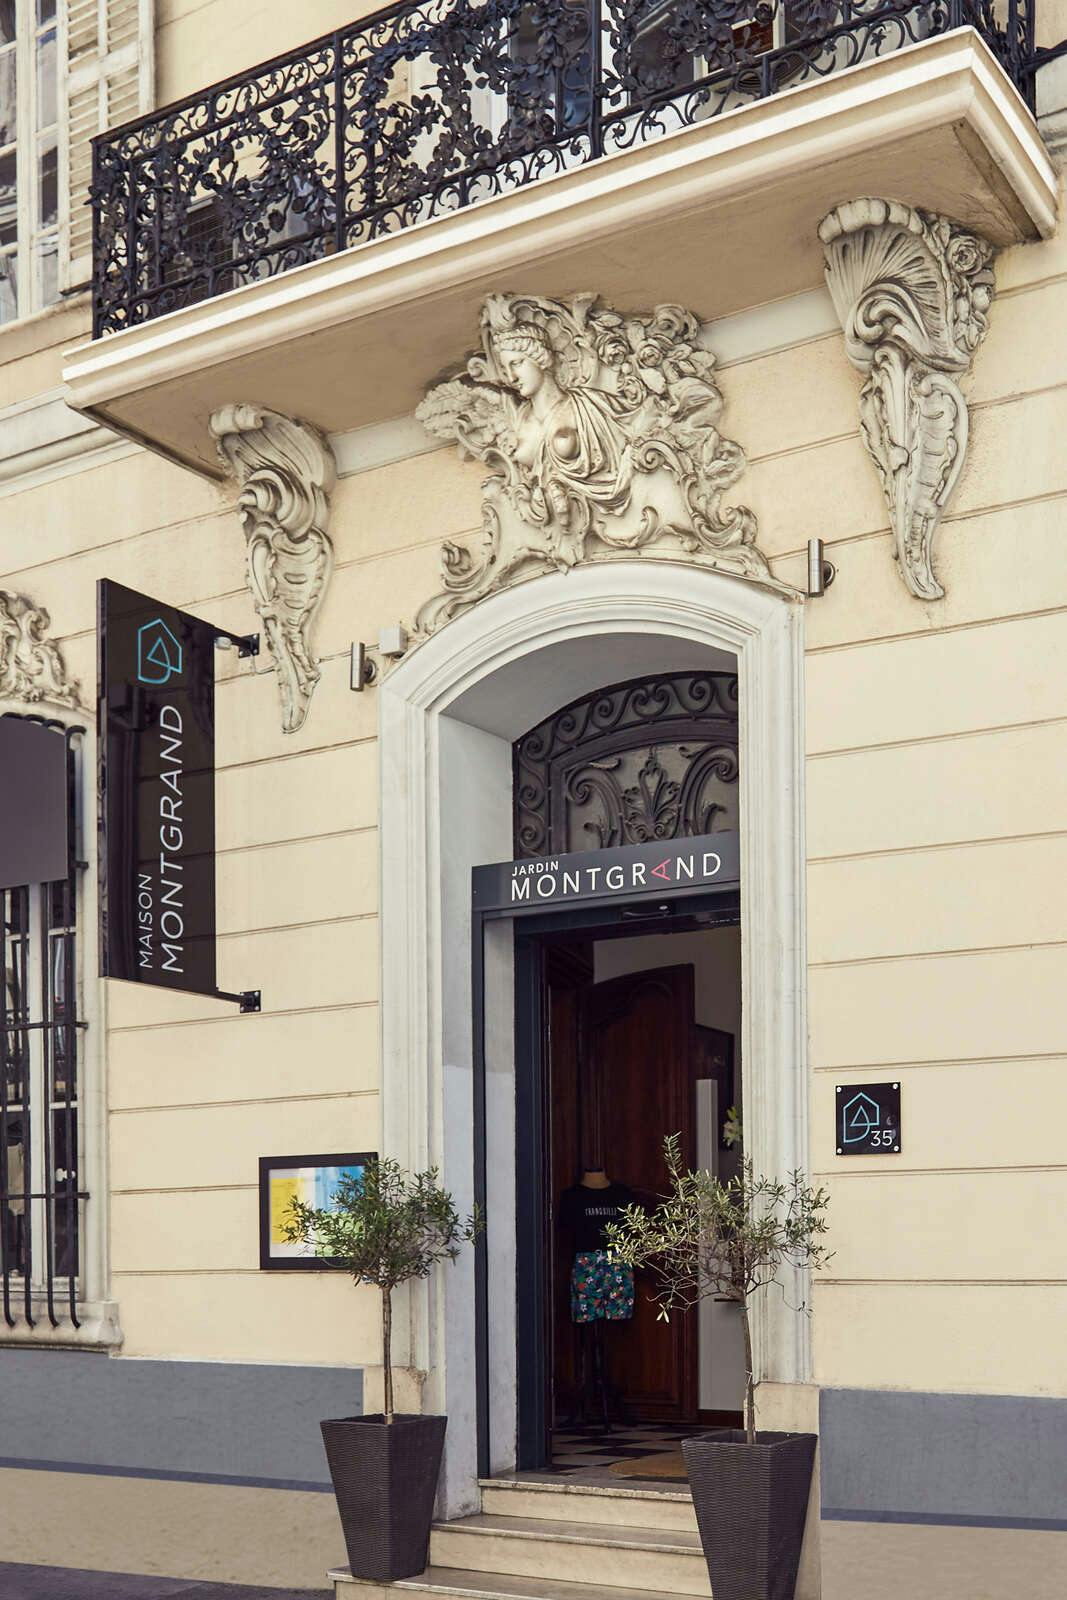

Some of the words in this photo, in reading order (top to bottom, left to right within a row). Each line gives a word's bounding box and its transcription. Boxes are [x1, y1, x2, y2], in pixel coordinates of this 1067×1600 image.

[159, 704, 184, 974] MONTGRAND
[510, 852, 722, 902] MONTGRAND
[511, 860, 560, 877] JARDIN
[138, 873, 153, 969] MAISON
[870, 1130, 893, 1147] 35
